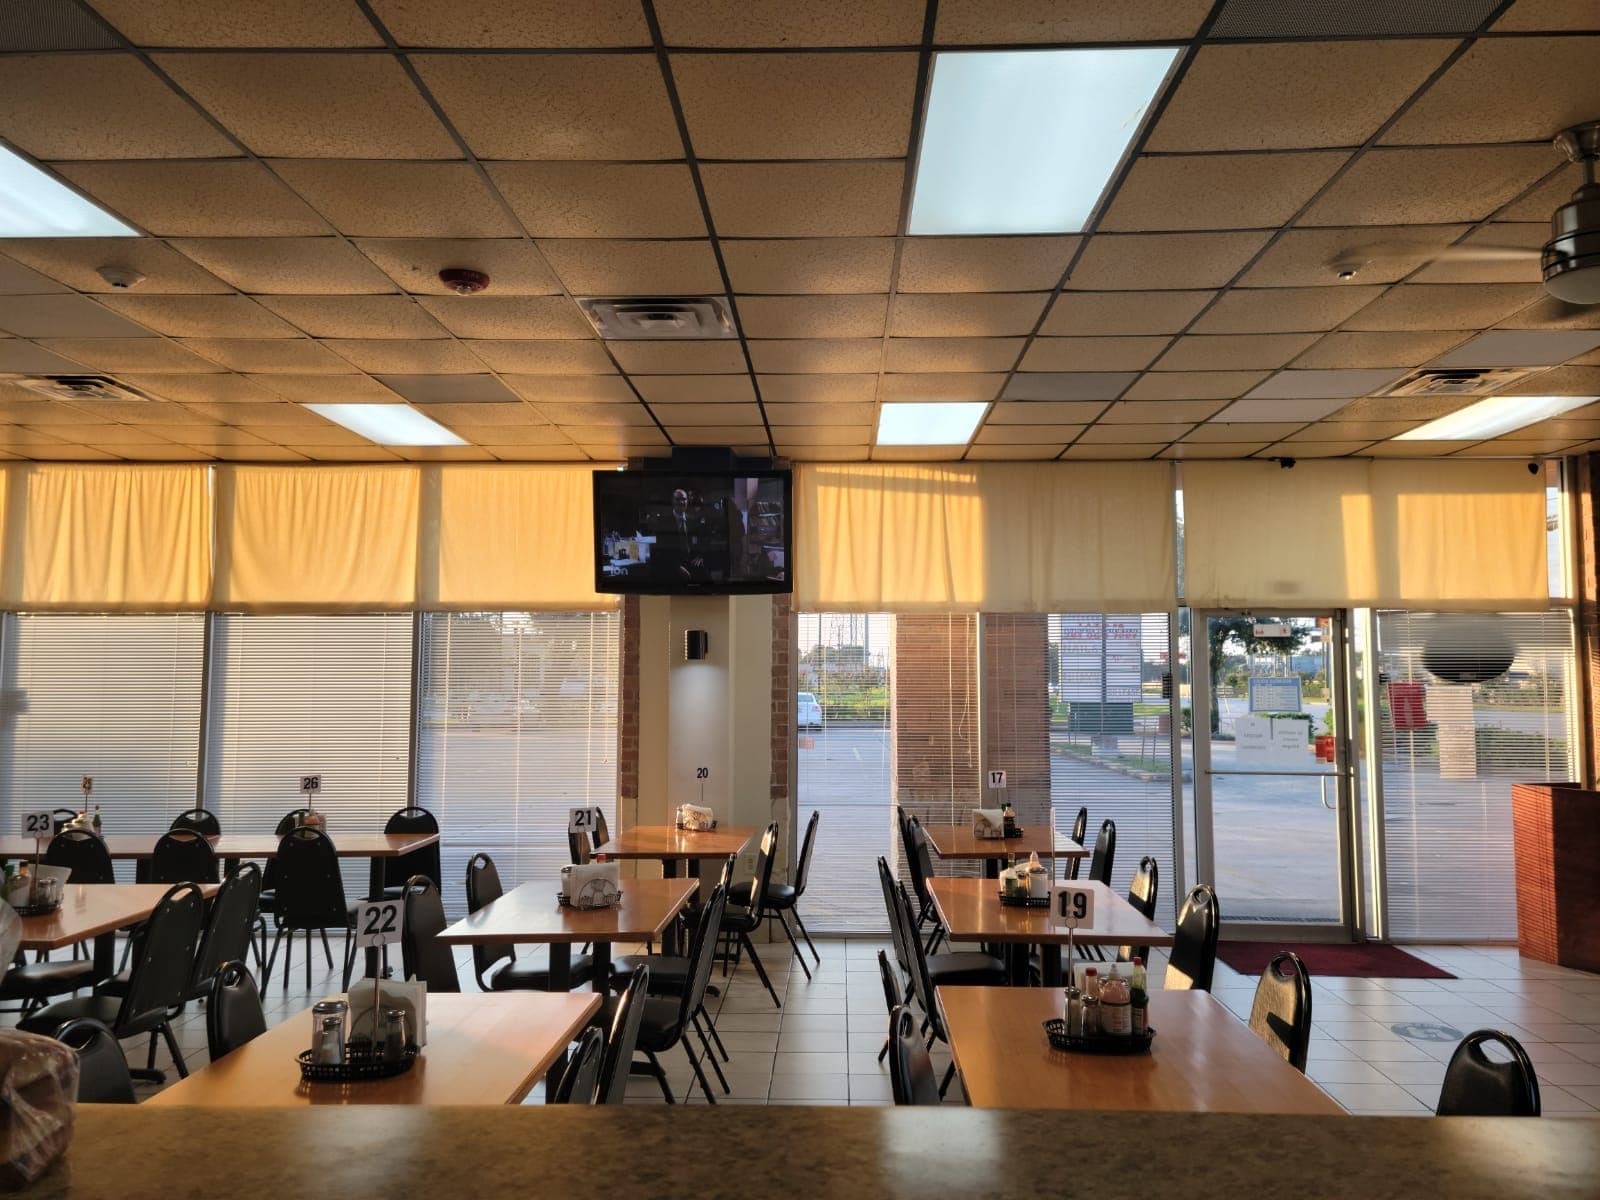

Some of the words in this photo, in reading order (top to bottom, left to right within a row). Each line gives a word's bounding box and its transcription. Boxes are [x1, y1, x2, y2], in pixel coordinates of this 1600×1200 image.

[696, 767, 709, 779] 20
[991, 772, 1003, 784] 17
[303, 776, 319, 790] 26
[26, 814, 50, 832] 23
[574, 810, 592, 826] 21
[1058, 890, 1087, 919] 19
[363, 904, 397, 936] 22
